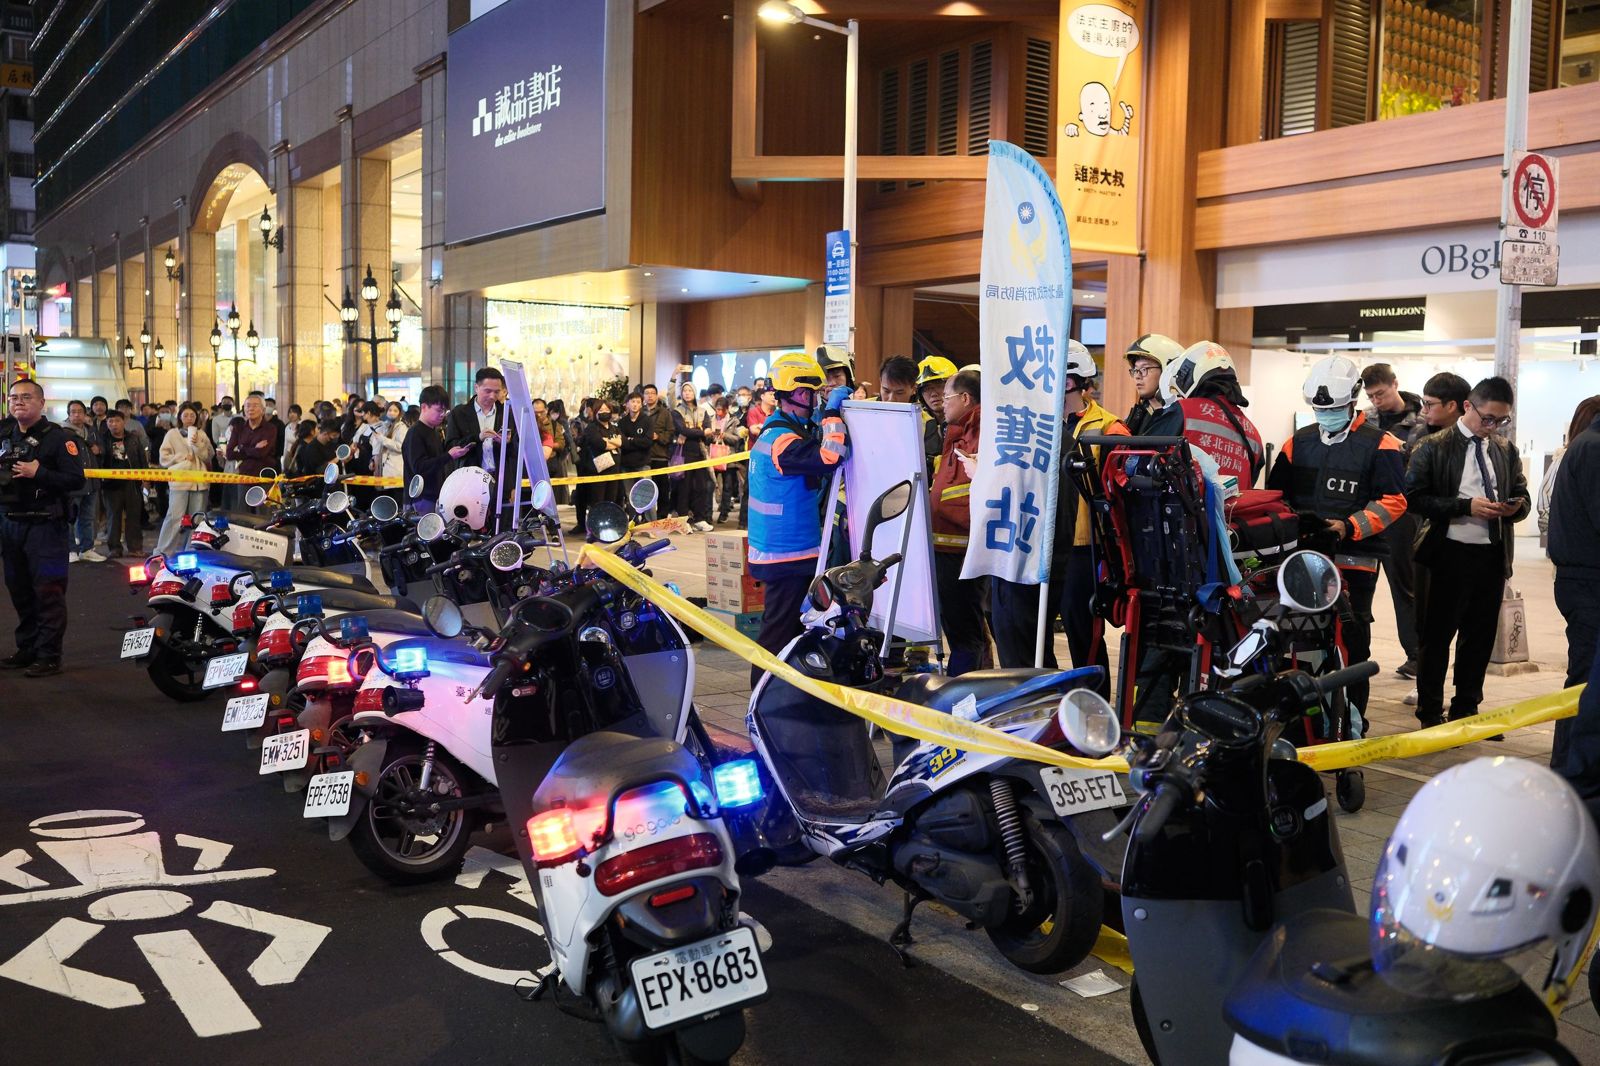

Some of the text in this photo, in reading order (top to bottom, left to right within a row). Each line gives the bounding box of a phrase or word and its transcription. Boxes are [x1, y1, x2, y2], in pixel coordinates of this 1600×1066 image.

[495, 64, 562, 130] 誠品書店
[1074, 163, 1125, 188] 雞湯大叔
[1523, 172, 1546, 211] 停
[1533, 230, 1547, 241] 110
[1326, 477, 1358, 494] CIT
[262, 740, 305, 766] EMW-3251
[929, 746, 958, 774] 39
[307, 782, 350, 807] EPE-7538
[1051, 774, 1122, 808] 395-EFZ
[641, 946, 758, 1012] EPX-8683
